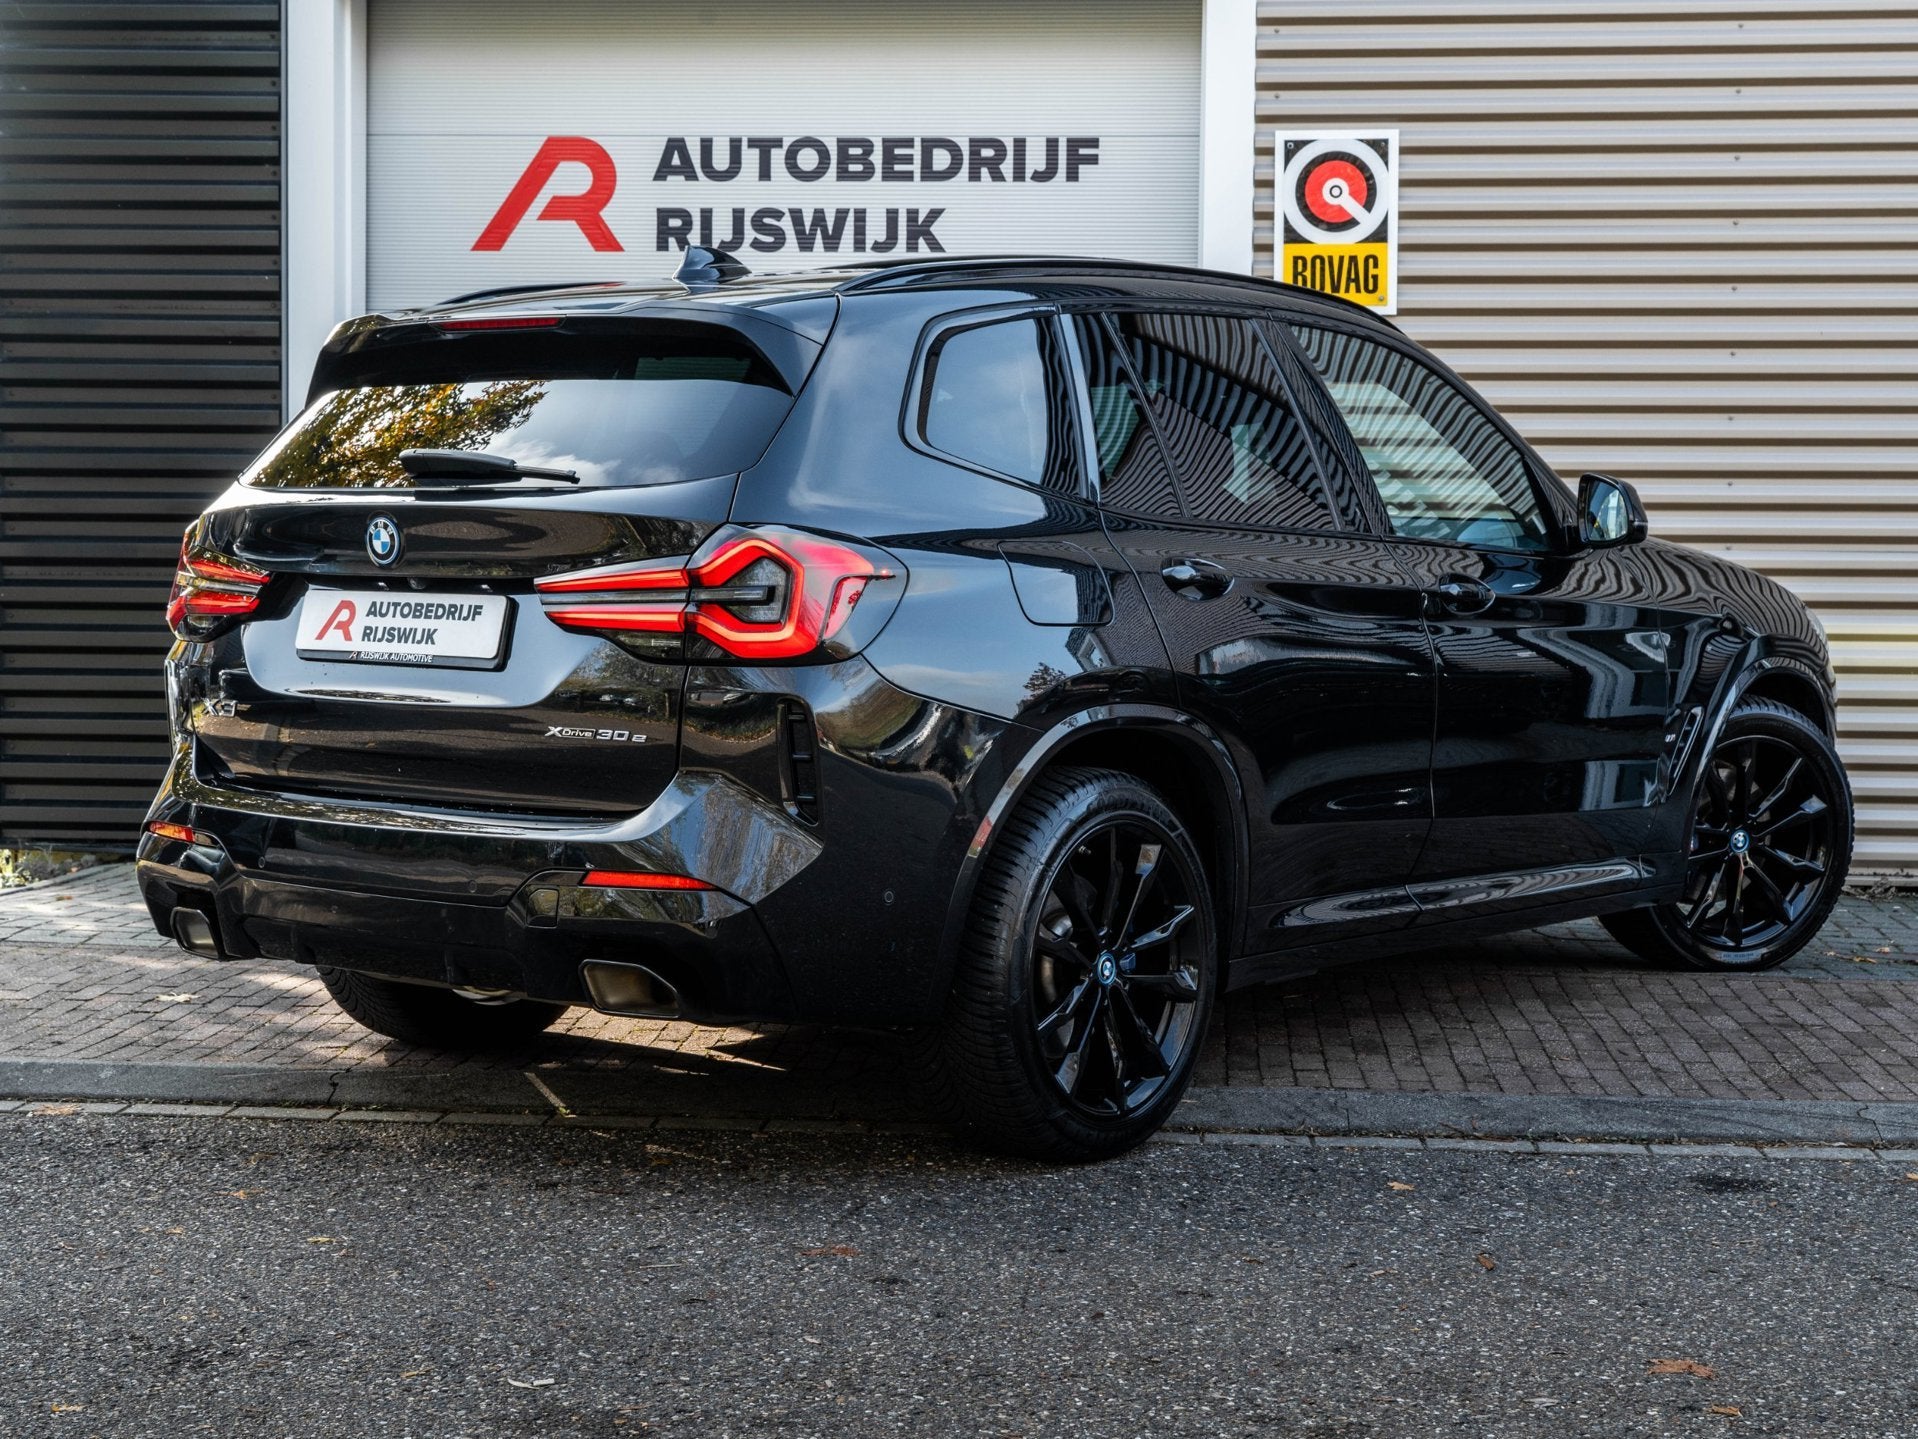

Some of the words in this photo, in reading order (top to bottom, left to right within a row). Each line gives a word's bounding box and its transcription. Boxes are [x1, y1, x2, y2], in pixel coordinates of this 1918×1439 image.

[653, 136, 1100, 183] AUTOBEDRIJF
[656, 206, 947, 253] RIJSWIJK
[1292, 254, 1379, 294] BOVAG
[365, 601, 484, 621] AUTOBEDRIJF
[361, 626, 438, 645] RIJSWIJK
[360, 651, 390, 661] RIJSWIJK
[390, 653, 433, 663] AUTOMOTIVE
[201, 698, 238, 717] X3
